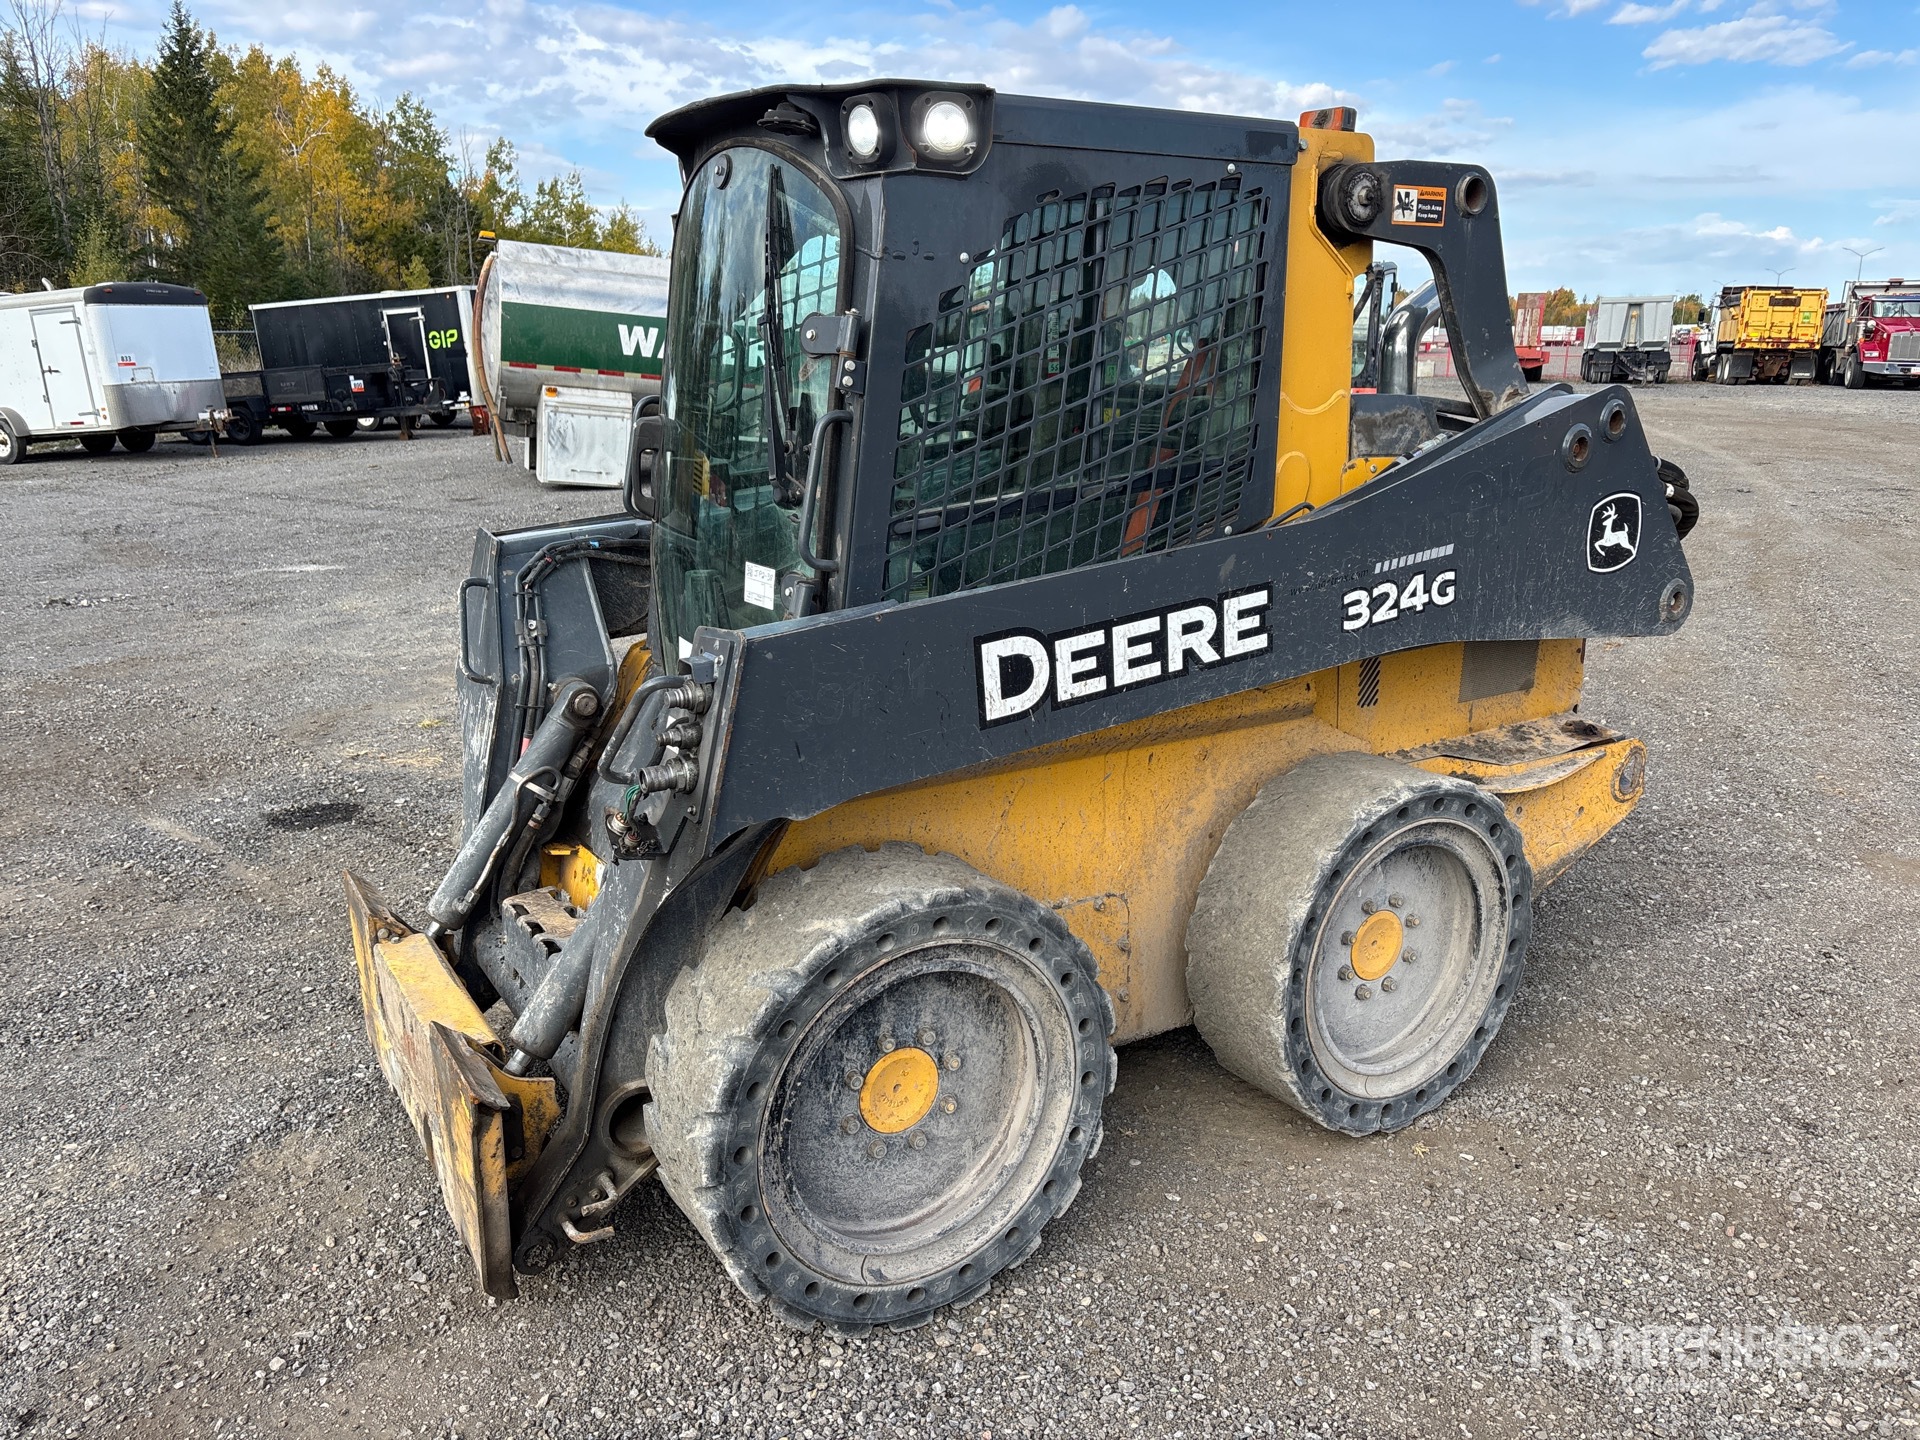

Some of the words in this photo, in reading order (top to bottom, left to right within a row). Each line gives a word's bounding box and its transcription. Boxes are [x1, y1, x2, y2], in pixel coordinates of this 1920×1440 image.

[428, 329, 458, 349] GIP
[1343, 571, 1455, 630] 324G
[980, 590, 1268, 721] DEERE
